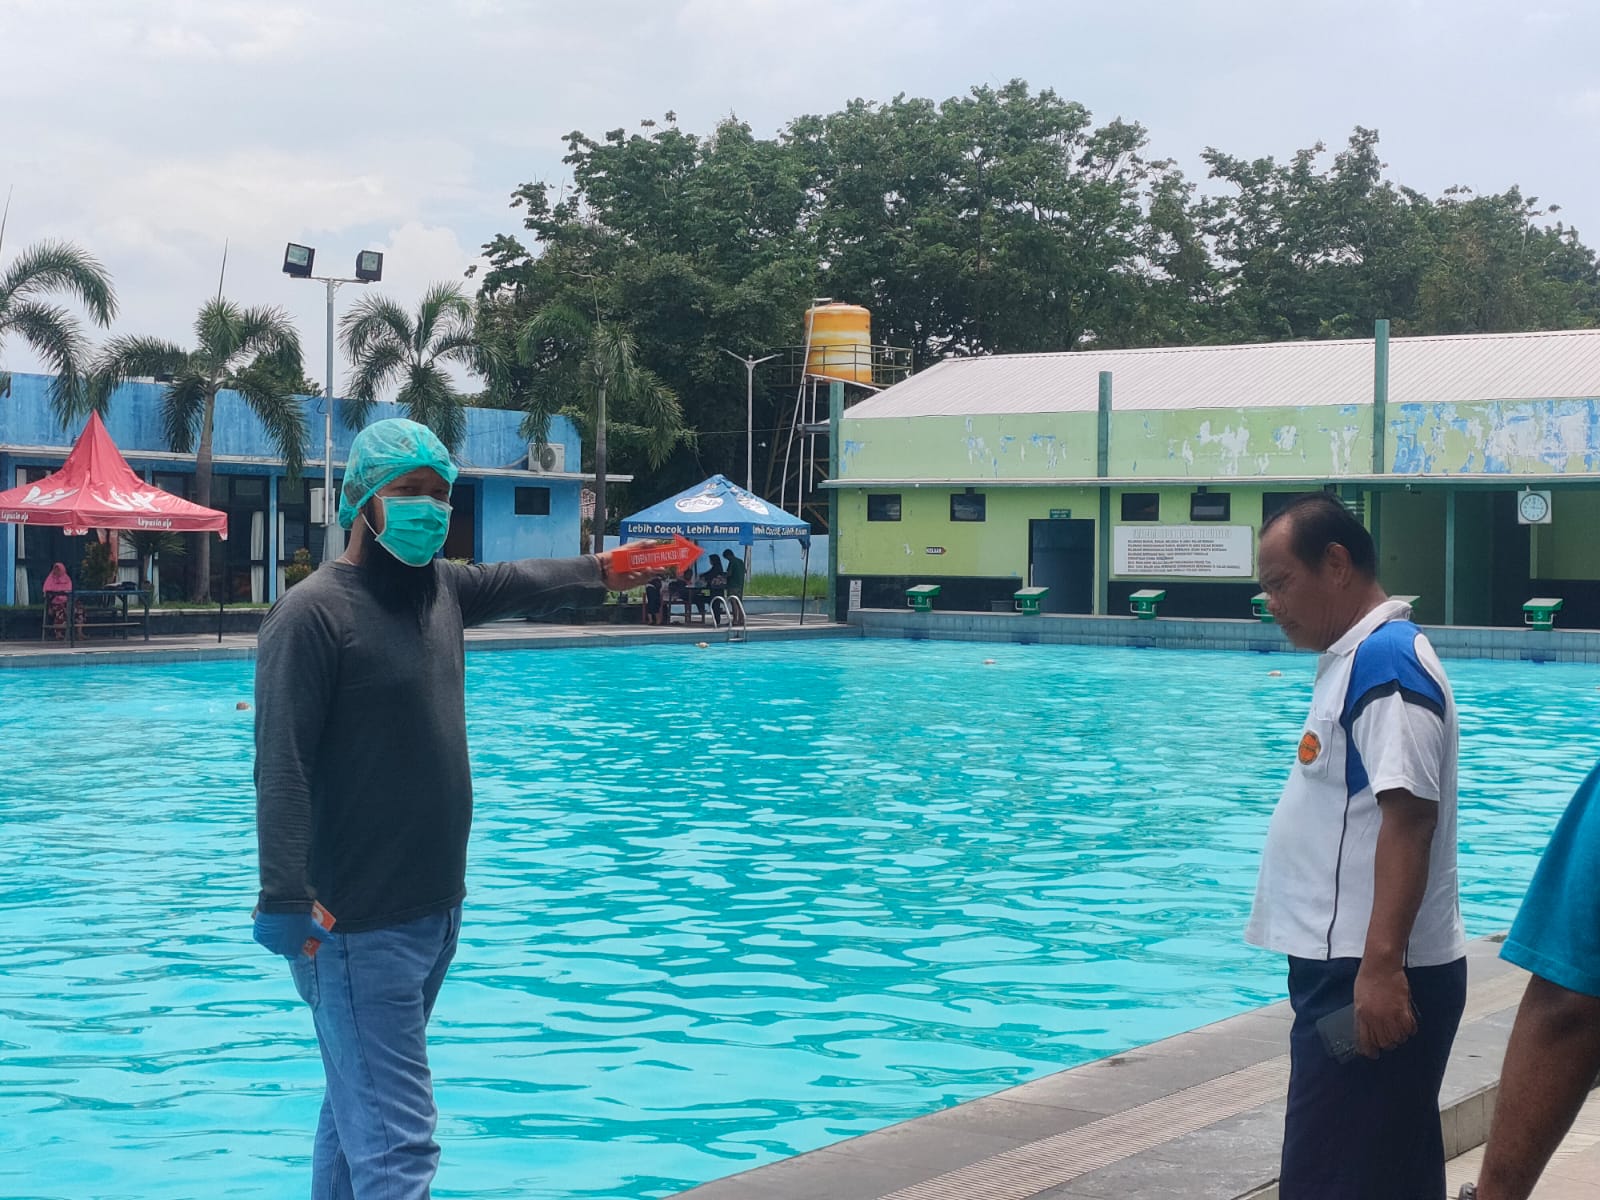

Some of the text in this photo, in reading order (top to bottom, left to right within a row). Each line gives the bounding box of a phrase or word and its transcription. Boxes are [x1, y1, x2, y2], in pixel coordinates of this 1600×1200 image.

[628, 524, 740, 535] Lebih Cocok, Lebih Aman
